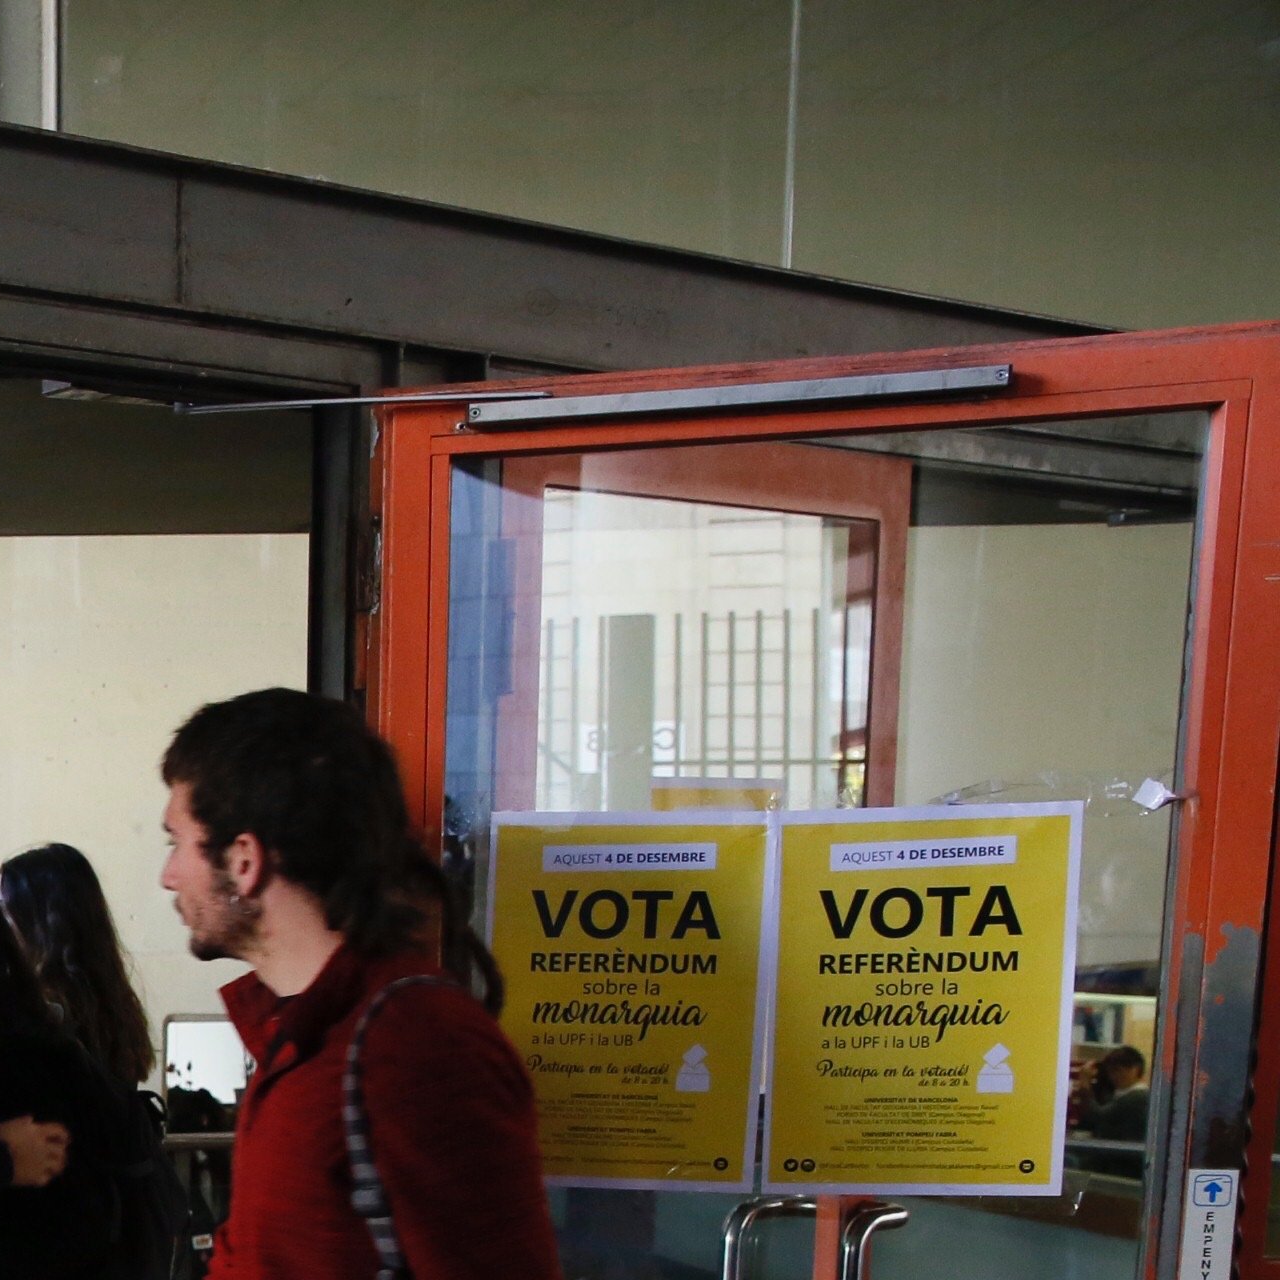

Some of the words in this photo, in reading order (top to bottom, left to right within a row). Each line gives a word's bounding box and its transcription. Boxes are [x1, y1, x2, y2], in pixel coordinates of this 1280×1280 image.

[554, 854, 602, 865] AQUEST
[605, 854, 612, 863] 4
[616, 854, 633, 863] DE
[637, 852, 706, 863] DESEMBRE
[842, 851, 892, 864] AQUEST
[897, 850, 905, 861] 4
[909, 849, 928, 860] DE
[931, 845, 1004, 859] DESEMBRE
[532, 889, 721, 940] VOTA
[819, 885, 1022, 939] VOTA
[531, 948, 717, 974] REFERÈNDUM
[819, 947, 1018, 975] REFERÈNDUM
[583, 978, 637, 996] sobre
[645, 979, 660, 996] la
[876, 980, 933, 996] sobre
[942, 978, 958, 995] la
[532, 1000, 707, 1041] monarquia
[822, 999, 1010, 1043] monarquia
[532, 1036, 539, 1045] a
[544, 1033, 554, 1045] la
[560, 1034, 586, 1045] UPF
[598, 1034, 609, 1046] la
[614, 1034, 633, 1046] UB
[822, 1039, 830, 1049] a
[835, 1036, 846, 1049] la
[852, 1036, 880, 1048] UPF
[893, 1036, 904, 1048] la
[910, 1036, 930, 1048] UB
[528, 1054, 584, 1078] Participa
[589, 1064, 602, 1074] en
[607, 1062, 618, 1074] la
[817, 1059, 878, 1083] Participa
[884, 1068, 897, 1077] en
[903, 1066, 915, 1077] la
[920, 1064, 970, 1077] votació!
